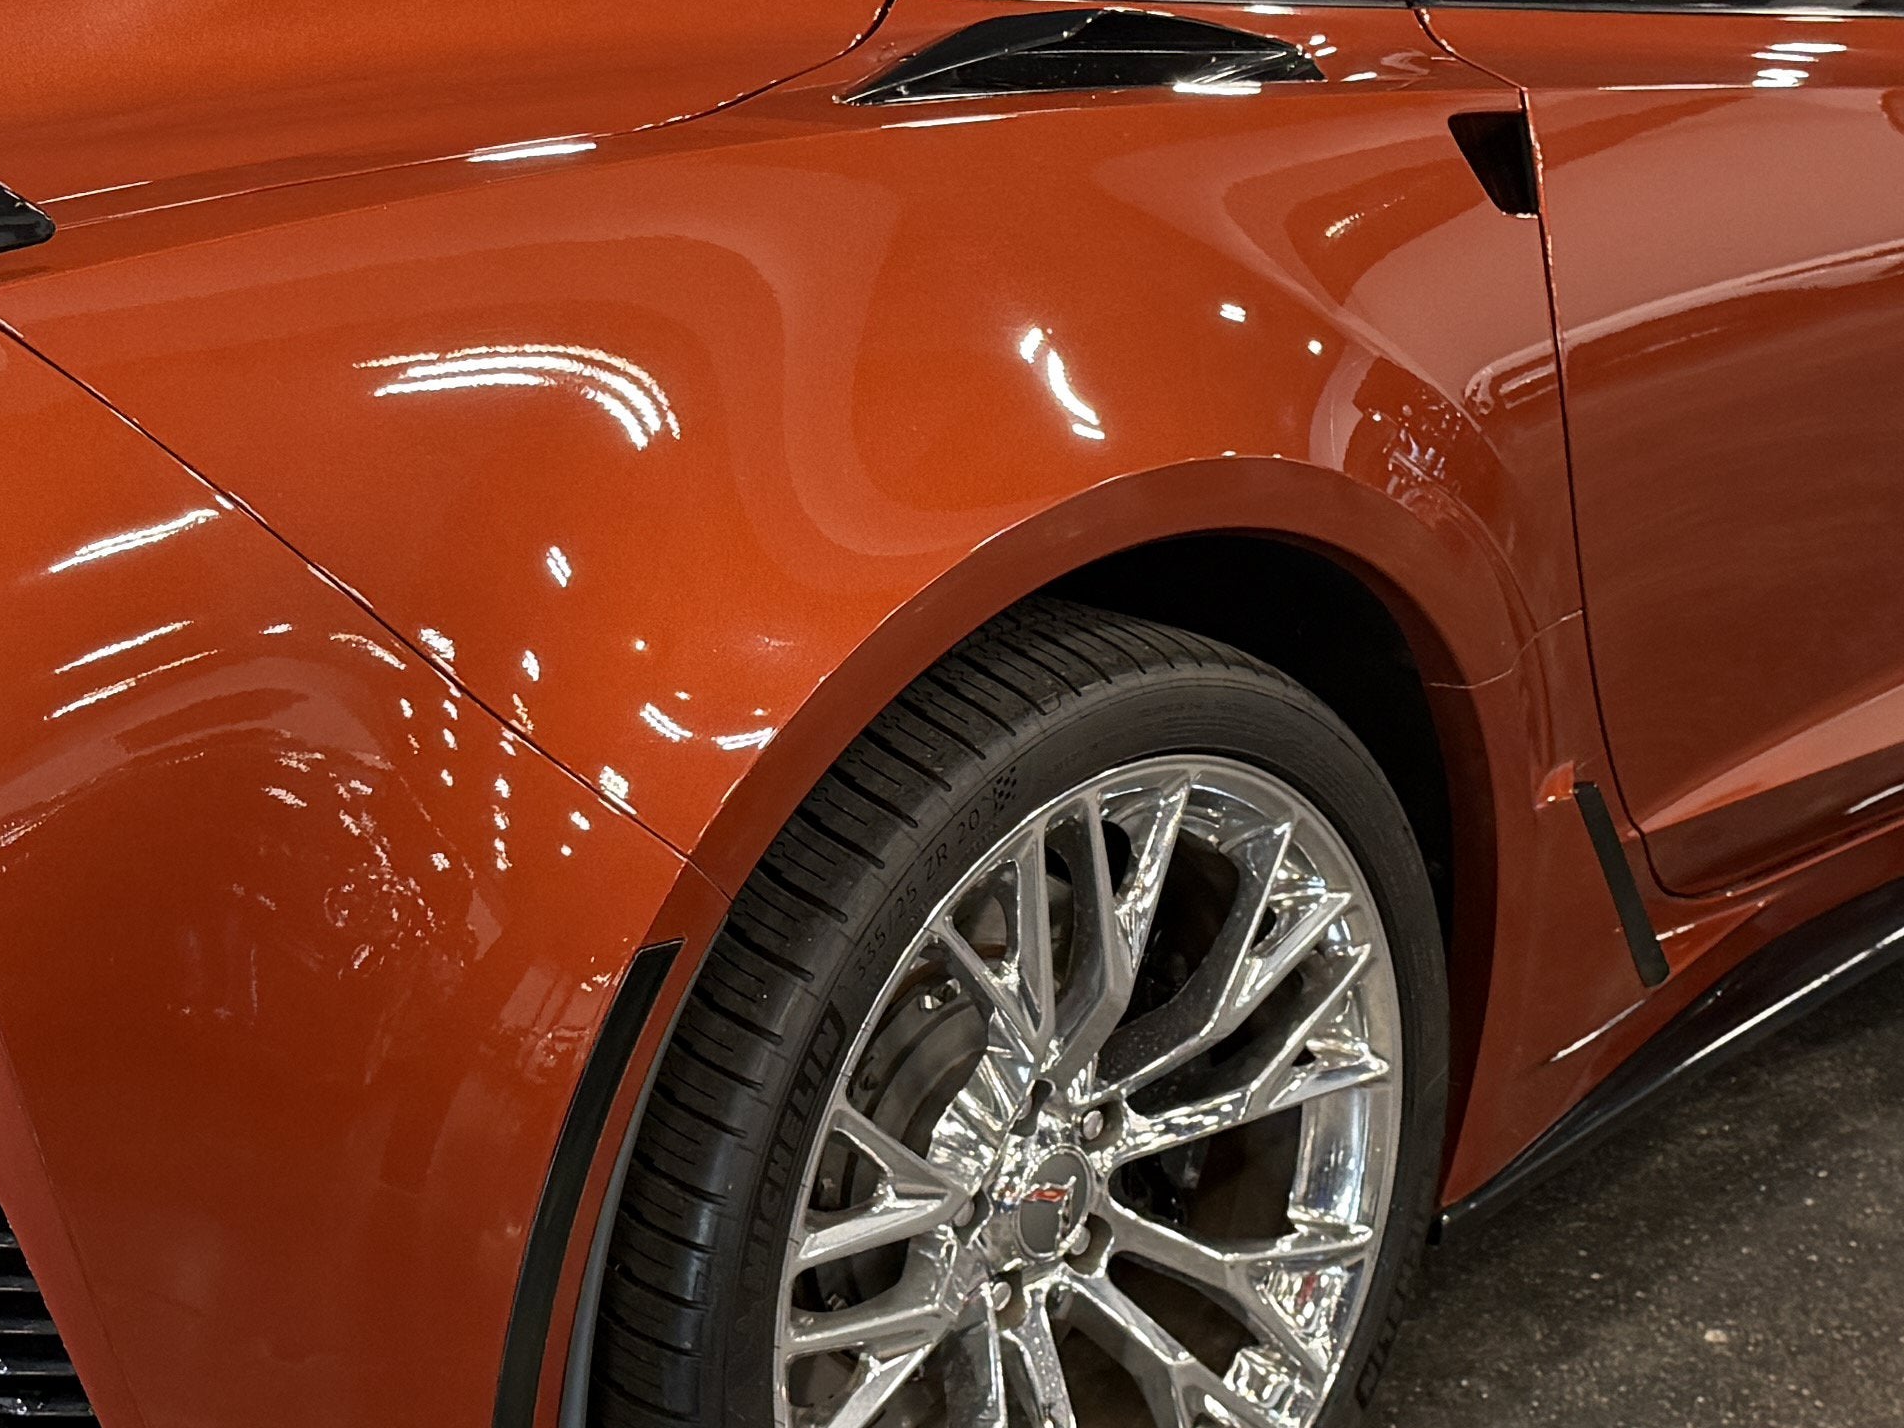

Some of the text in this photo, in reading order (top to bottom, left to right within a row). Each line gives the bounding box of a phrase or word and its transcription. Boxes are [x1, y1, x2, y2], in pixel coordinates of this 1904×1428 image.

[923, 842, 948, 882] ZR
[957, 808, 981, 844] 20
[741, 1004, 845, 1284] MICHELIN
